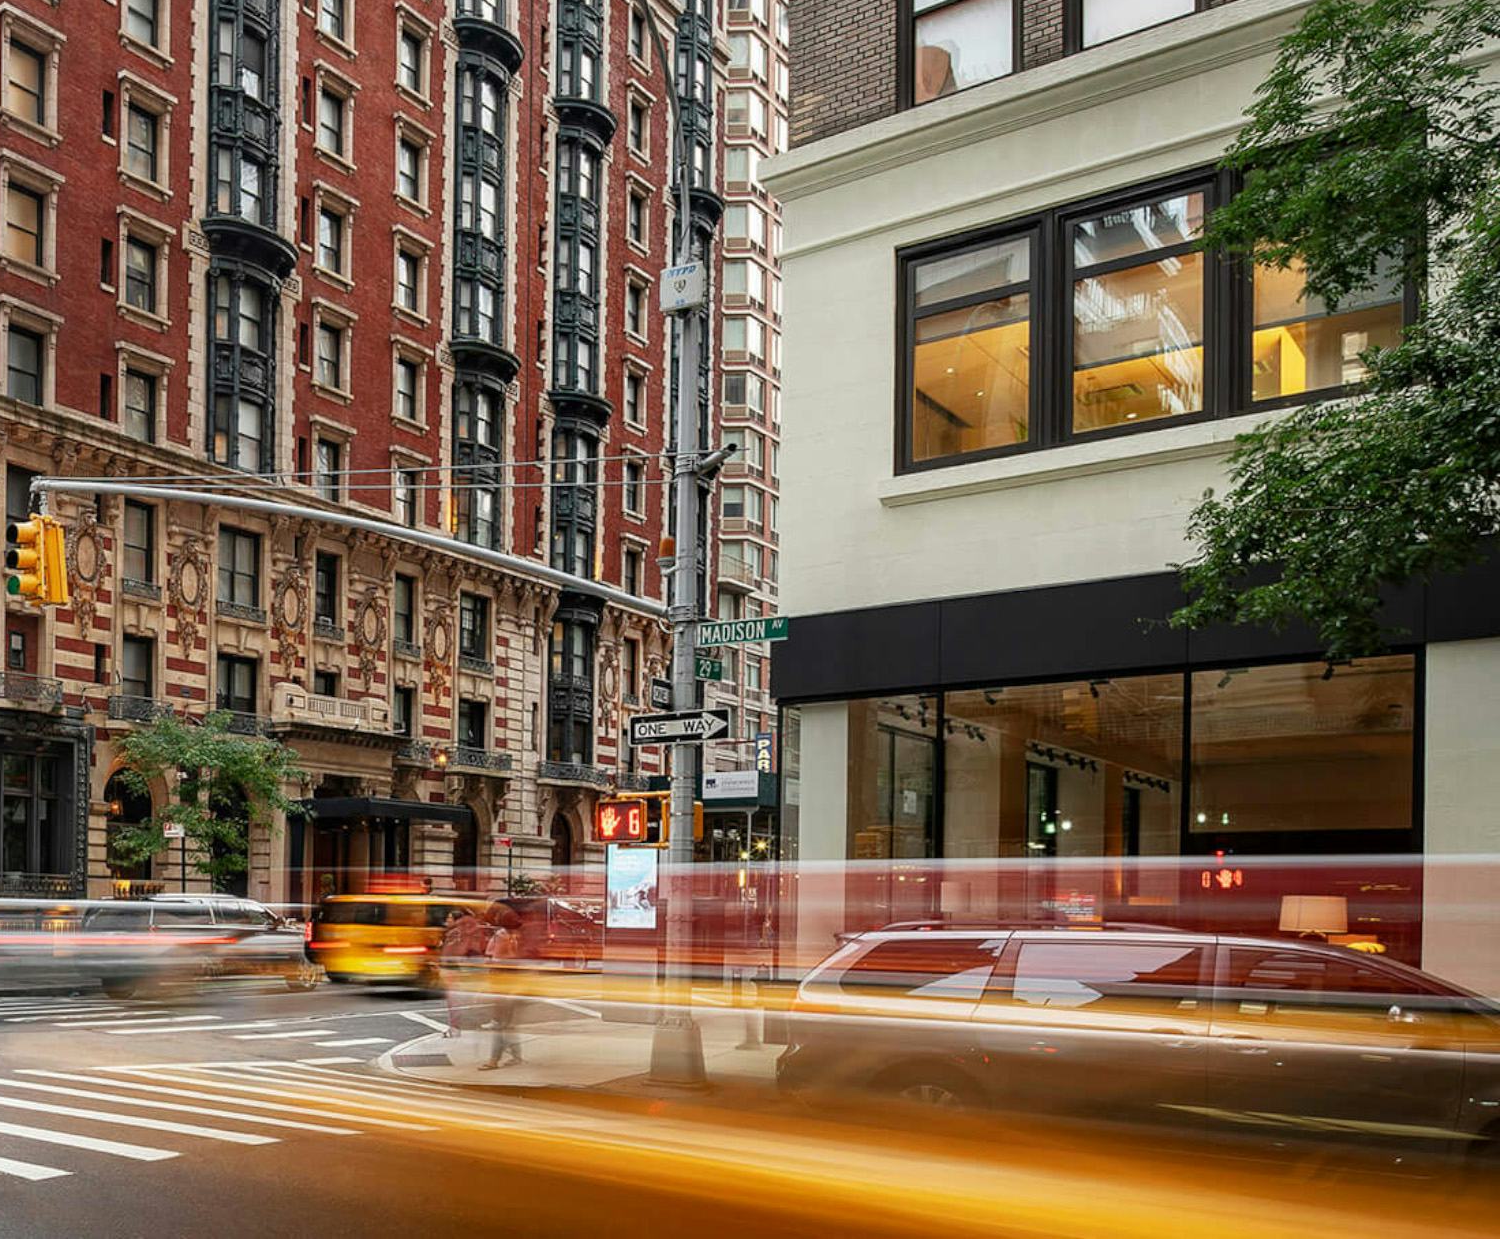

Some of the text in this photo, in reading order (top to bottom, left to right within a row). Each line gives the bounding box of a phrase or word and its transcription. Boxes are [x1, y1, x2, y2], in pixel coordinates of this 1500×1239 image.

[702, 619, 784, 643] MADISON AV
[699, 660, 711, 677] 29
[638, 718, 715, 735] ONE WAY
[628, 808, 640, 835] 6
